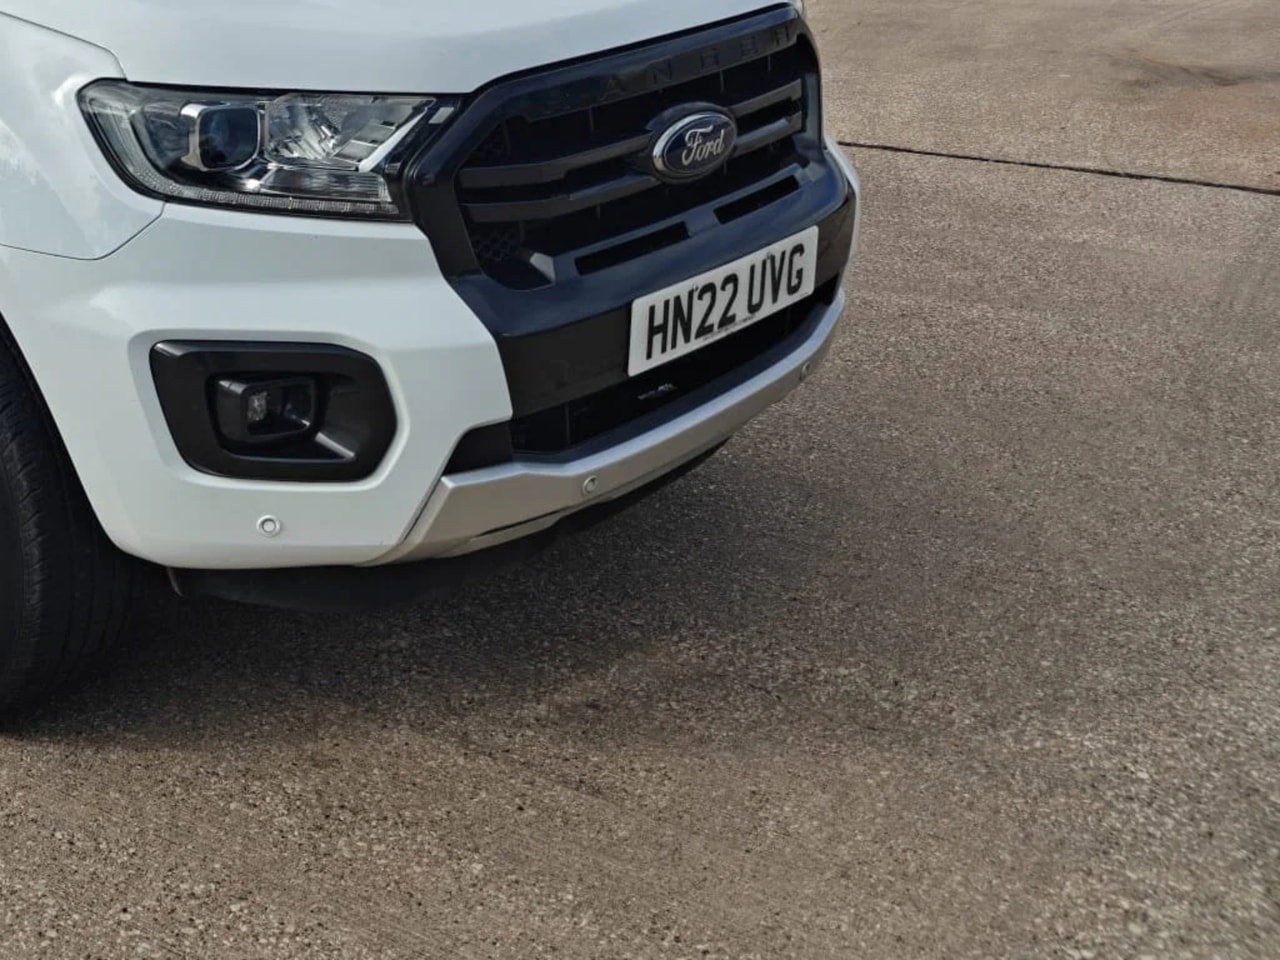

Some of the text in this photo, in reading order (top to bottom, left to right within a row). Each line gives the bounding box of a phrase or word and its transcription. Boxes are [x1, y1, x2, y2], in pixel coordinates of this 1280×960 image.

[682, 125, 725, 166] Ford
[646, 243, 806, 361] HN22 UVG
